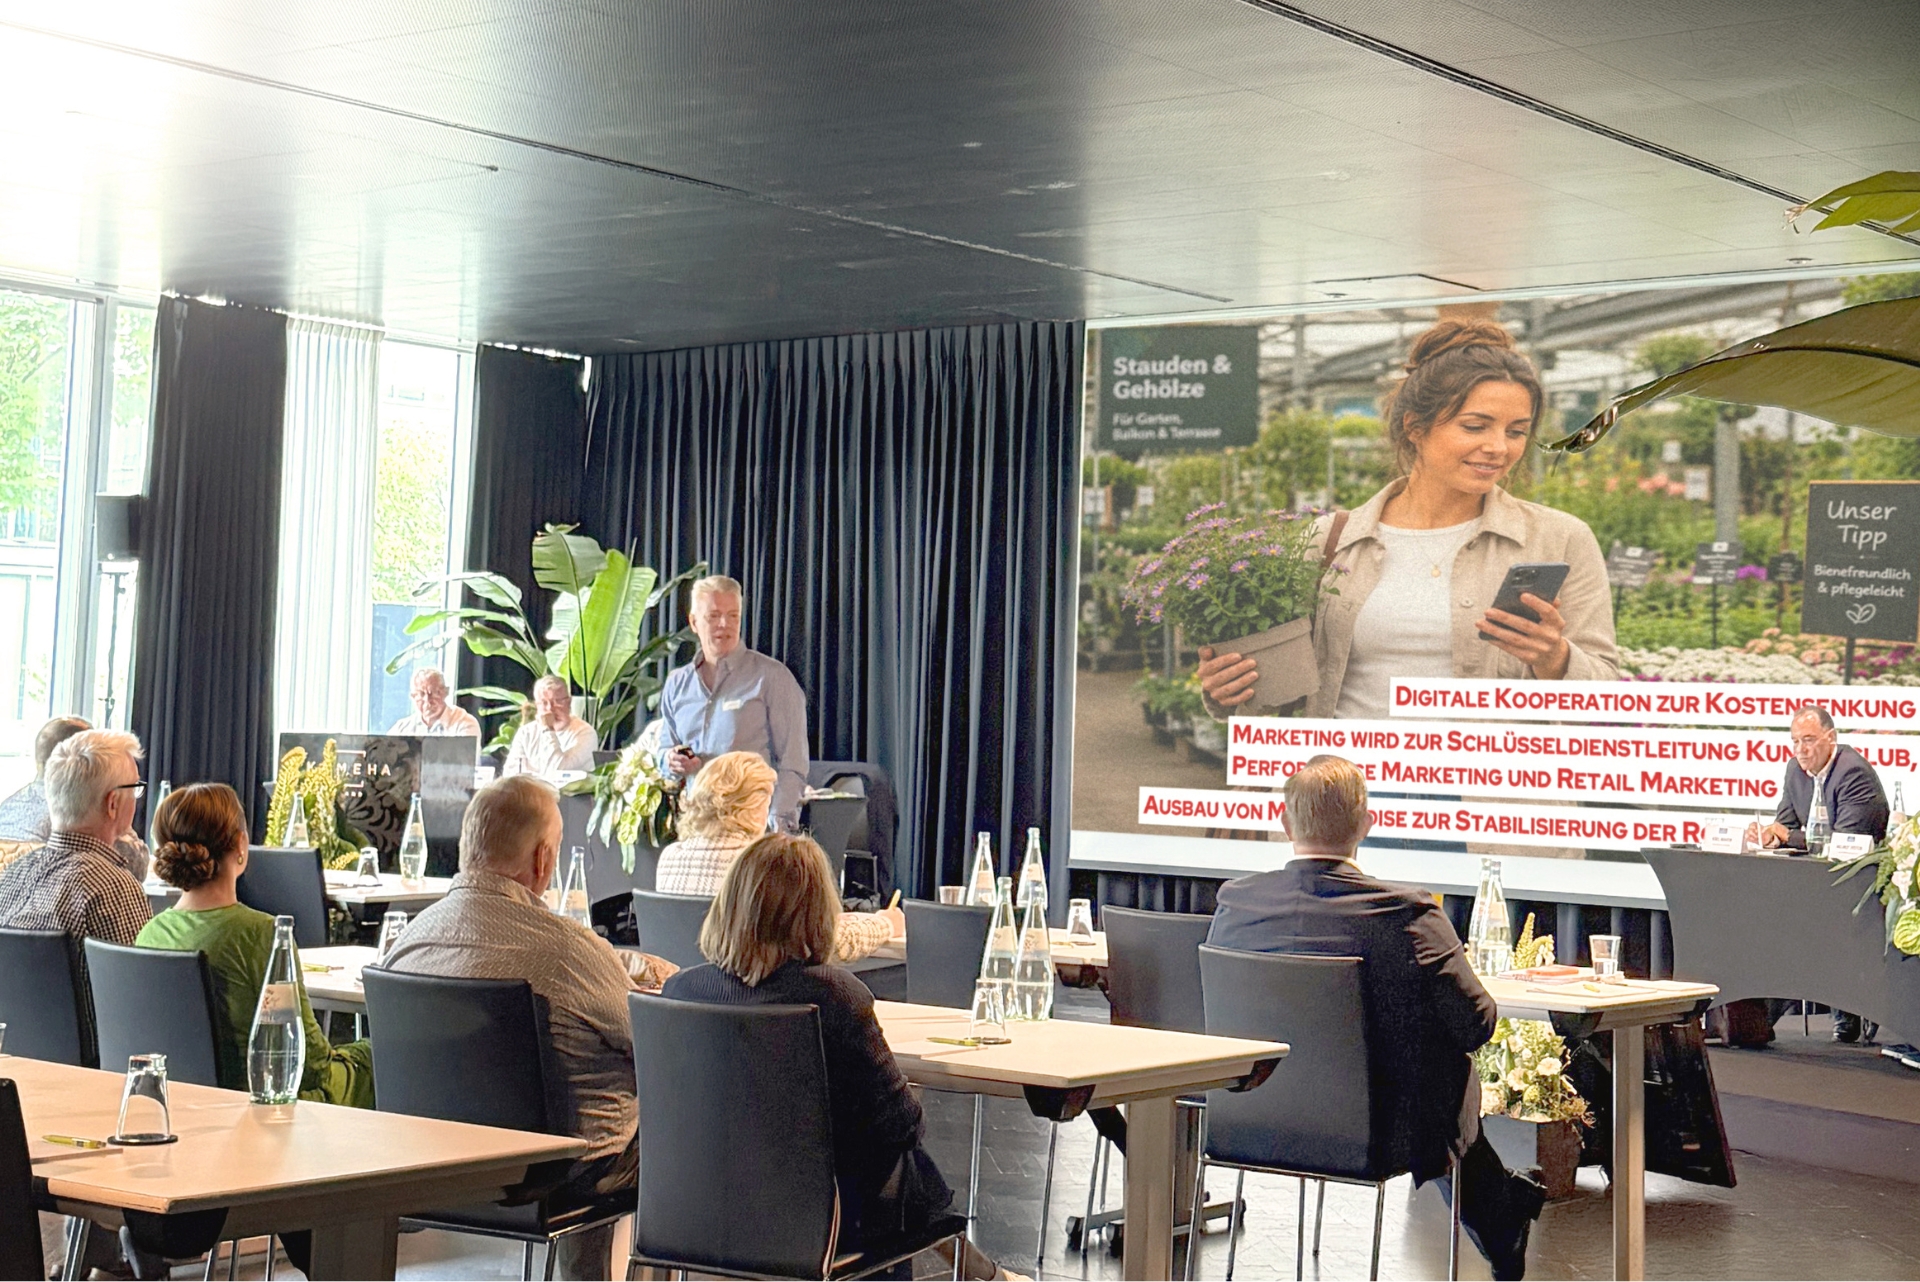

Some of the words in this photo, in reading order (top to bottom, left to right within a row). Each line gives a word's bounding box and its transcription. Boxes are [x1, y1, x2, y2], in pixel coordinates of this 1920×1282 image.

[1113, 355, 1207, 375] Stauden
[1212, 354, 1232, 374] &
[1113, 378, 1205, 399] Gehölze
[1112, 412, 1133, 425] Für
[1157, 426, 1168, 439] &
[1827, 500, 1897, 520] Unser
[1837, 524, 1887, 550] Tipp
[1814, 564, 1911, 581] Bienefreundlich
[1817, 581, 1828, 594] &
[1831, 582, 1906, 598] pflegeleicht
[1395, 685, 1490, 709] DIGITALE
[1495, 687, 1653, 714] KOOPERATION
[1656, 695, 1700, 713] ZUR
[1233, 724, 1347, 748] MARKETING
[1350, 731, 1400, 749] WIRD
[1403, 733, 1443, 751] ZUR
[1447, 730, 1741, 761] SCHLÜSSELDIENSTLEITUNG
[1746, 739, 1918, 773] KUNLUB,
[306, 761, 391, 777] KMEHA
[1232, 755, 1377, 783] PERFORE
[1381, 761, 1503, 787] MARKETING
[1507, 769, 1552, 789] UND
[1557, 767, 1635, 792] RETAIL
[1640, 771, 1778, 799] MARKETING
[1143, 795, 1219, 818] AUSBAU
[1223, 802, 1263, 821] VON
[1411, 811, 1451, 832] ZUR
[1455, 809, 1629, 840] STABILISIERUNG
[1633, 822, 1677, 843] DER
